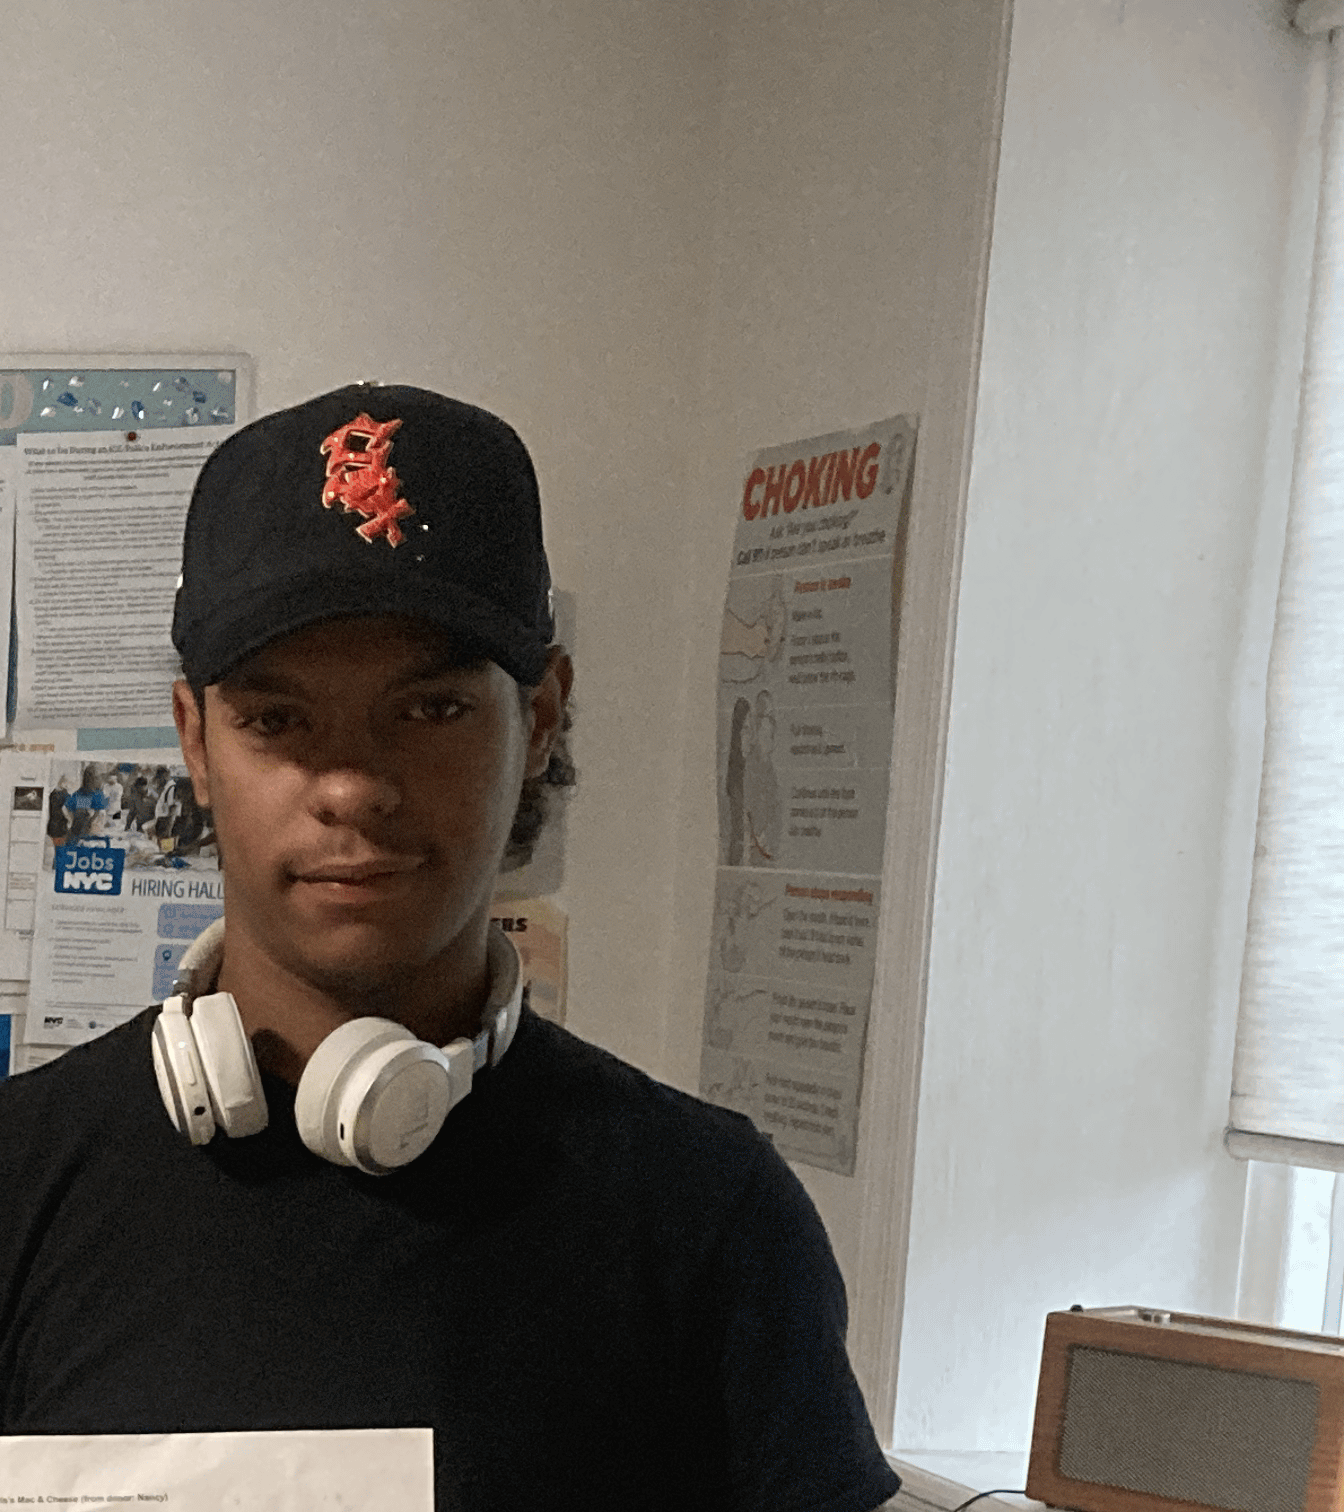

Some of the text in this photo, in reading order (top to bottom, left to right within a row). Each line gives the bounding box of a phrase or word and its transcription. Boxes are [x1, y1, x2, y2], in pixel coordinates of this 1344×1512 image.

[743, 441, 881, 521] CHOKING
[65, 850, 114, 871] Jobs
[63, 871, 114, 891] NYC
[131, 877, 224, 900] HIRING HALL
[18, 1496, 35, 1504] Mac
[38, 1496, 45, 1504] &
[47, 1495, 79, 1504] Cheese
[81, 1494, 104, 1505] (from
[138, 1492, 169, 1504] Nancy)
